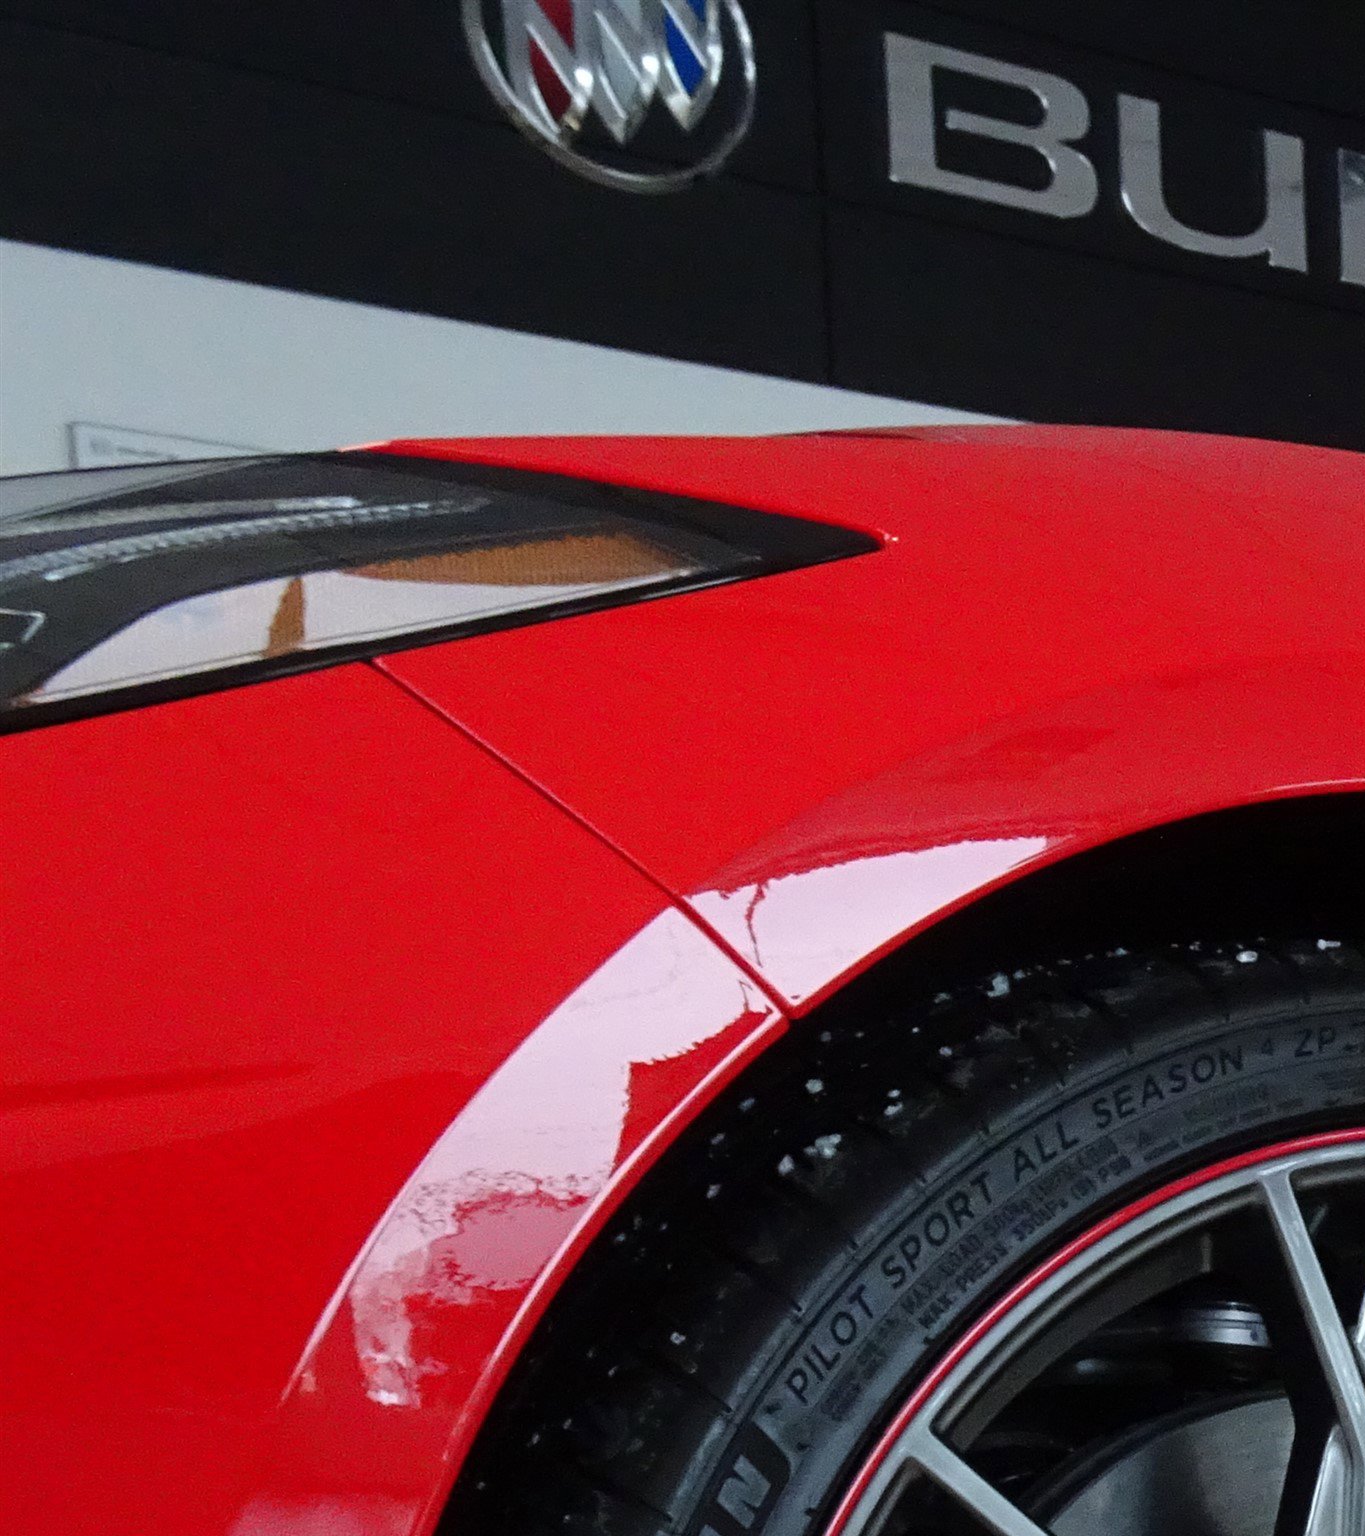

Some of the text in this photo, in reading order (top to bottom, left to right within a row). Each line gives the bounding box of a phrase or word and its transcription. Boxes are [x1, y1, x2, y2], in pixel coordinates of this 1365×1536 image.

[785, 1283, 875, 1404] PILOT
[880, 1169, 993, 1290] SPORT
[1012, 1120, 1080, 1183] ALL
[1091, 1045, 1245, 1129] SEASON
[1293, 1025, 1338, 1059] ZP
